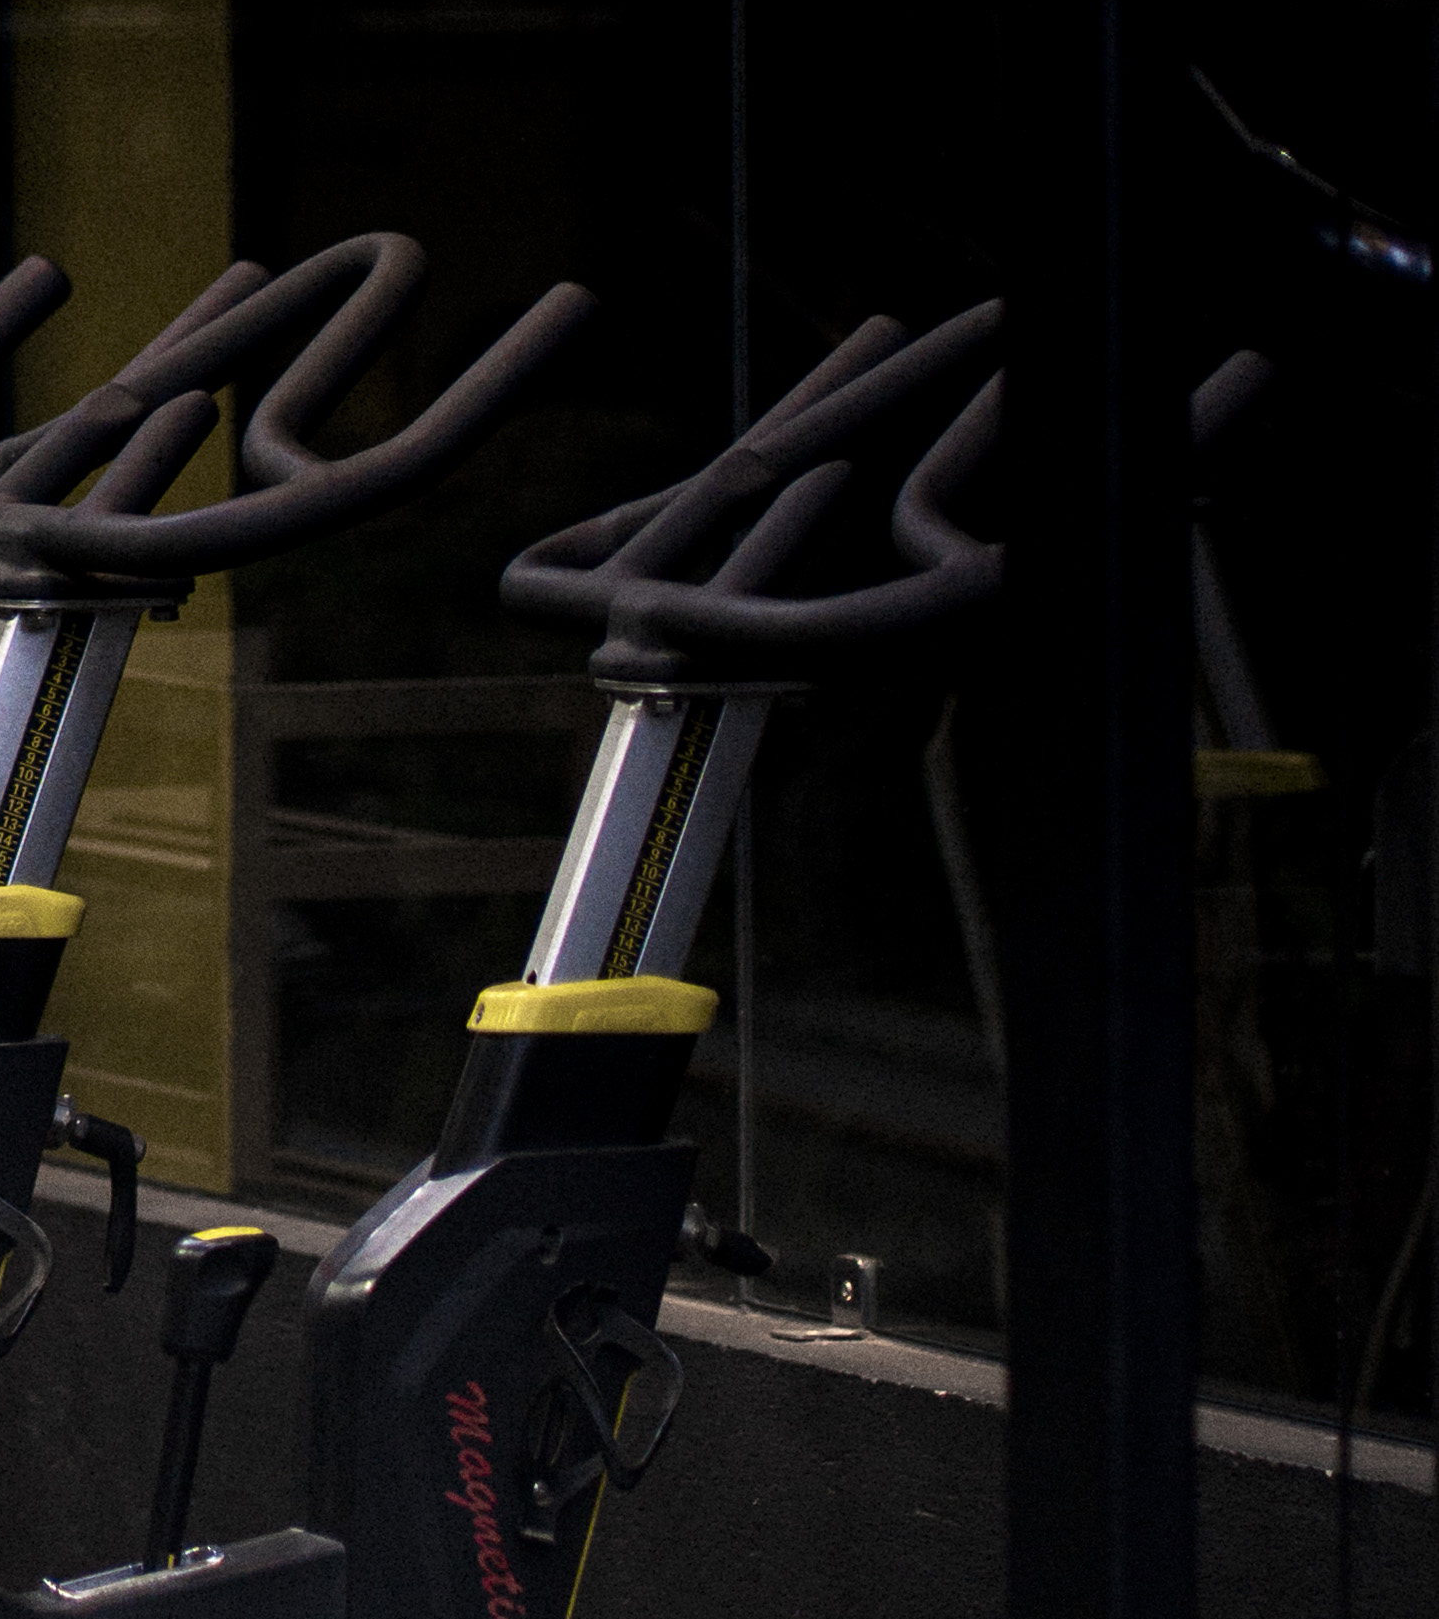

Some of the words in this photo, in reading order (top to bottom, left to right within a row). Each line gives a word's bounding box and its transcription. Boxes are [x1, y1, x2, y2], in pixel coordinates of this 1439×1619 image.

[59, 655, 66, 668] 3
[53, 672, 62, 684] 4
[48, 688, 56, 699] 5
[42, 704, 52, 716] 6
[38, 720, 46, 731] 7
[32, 736, 39, 748] 8
[686, 745, 695, 757] 3
[26, 752, 36, 764] 9
[19, 767, 32, 781] 10
[680, 763, 689, 776] 4
[13, 783, 26, 797] 11
[674, 780, 682, 792] 5
[8, 799, 23, 812] 12
[667, 797, 676, 809] 6
[3, 816, 18, 830] 13
[663, 814, 672, 827] 7
[656, 831, 665, 844] 8
[651, 849, 660, 860] 9
[642, 864, 658, 878] 10
[636, 882, 652, 896] 11
[630, 899, 646, 913] 12
[624, 917, 640, 932] 13
[618, 935, 634, 949] 14
[613, 952, 628, 967] 15
